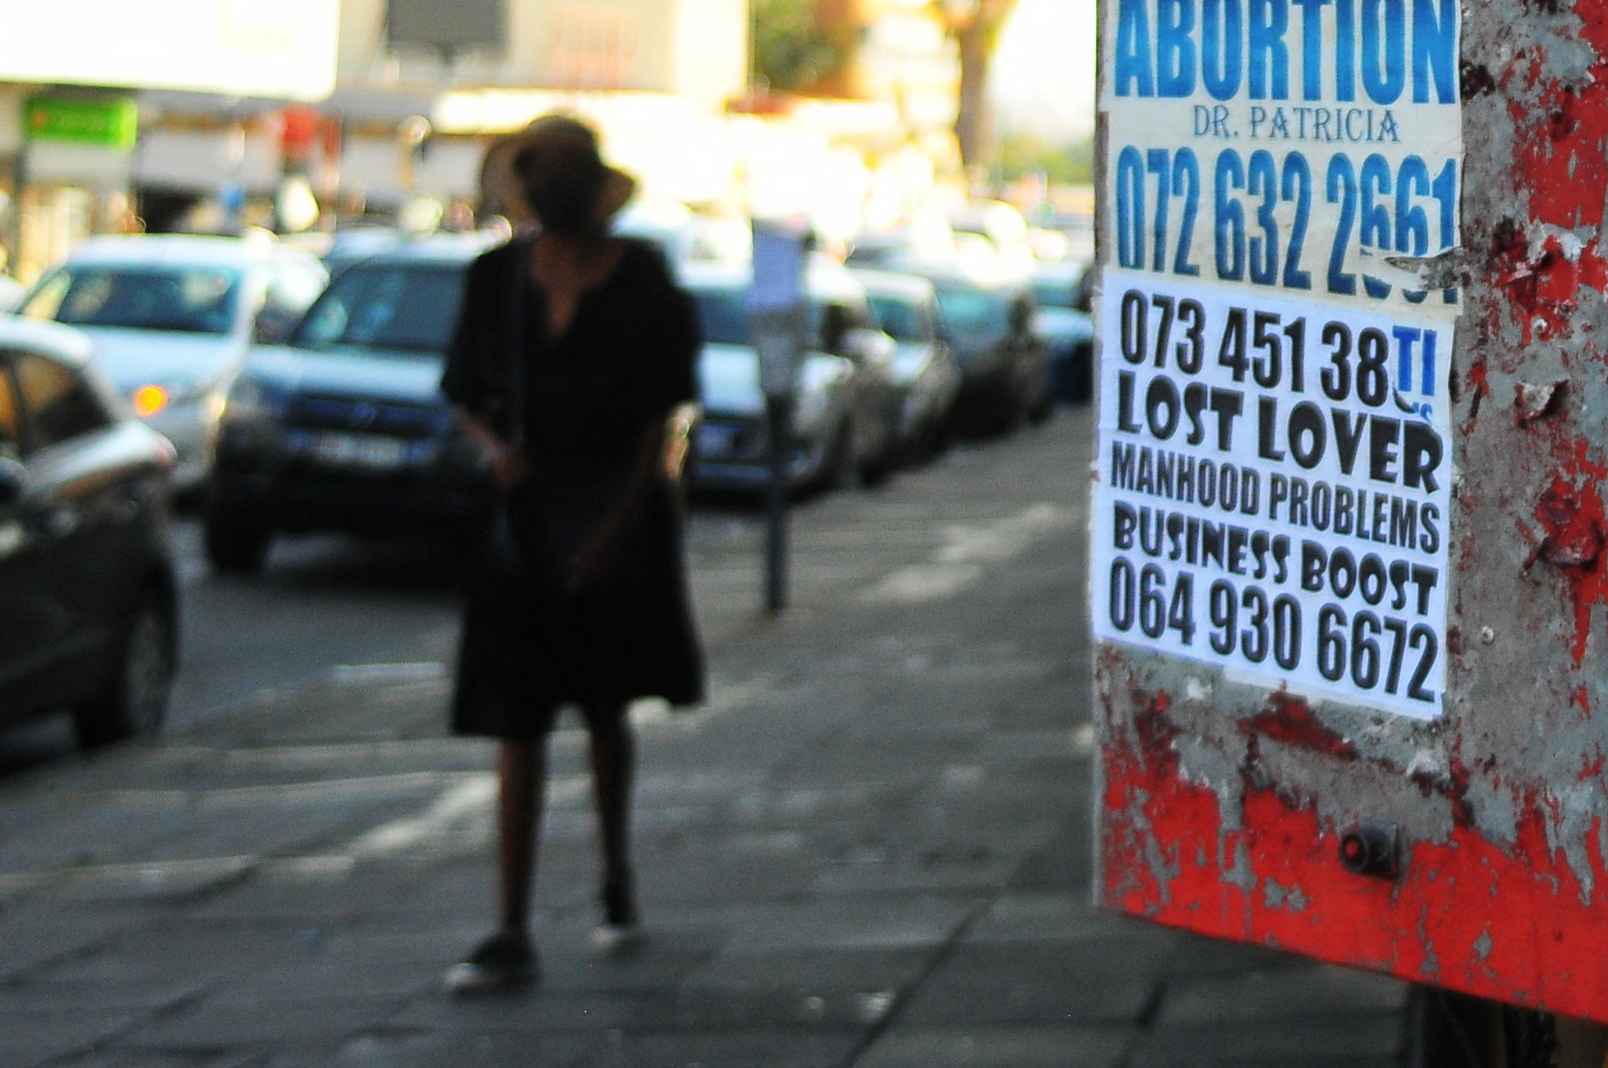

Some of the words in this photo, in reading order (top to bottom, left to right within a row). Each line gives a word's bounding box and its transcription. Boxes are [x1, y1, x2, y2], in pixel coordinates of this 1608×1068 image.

[1193, 104, 1238, 138] DR.
[1250, 108, 1401, 143] PATRICIA
[1115, 144, 1201, 277] 072
[1214, 147, 1312, 291] 632
[1325, 152, 1459, 305] 2661
[1119, 289, 1206, 375] 073
[1217, 306, 1306, 394] 451
[1320, 320, 1416, 414] 38
[1117, 369, 1245, 453] LOST
[1257, 394, 1444, 495] LOVER
[1110, 439, 1261, 516] MANHOOD
[1269, 471, 1440, 555] PROBLEMS
[1113, 499, 1291, 585] BUSINESS
[1301, 538, 1439, 616] BOOST
[1109, 555, 1196, 646] 064
[1209, 578, 1301, 671] 930
[1317, 601, 1439, 704] 6672
